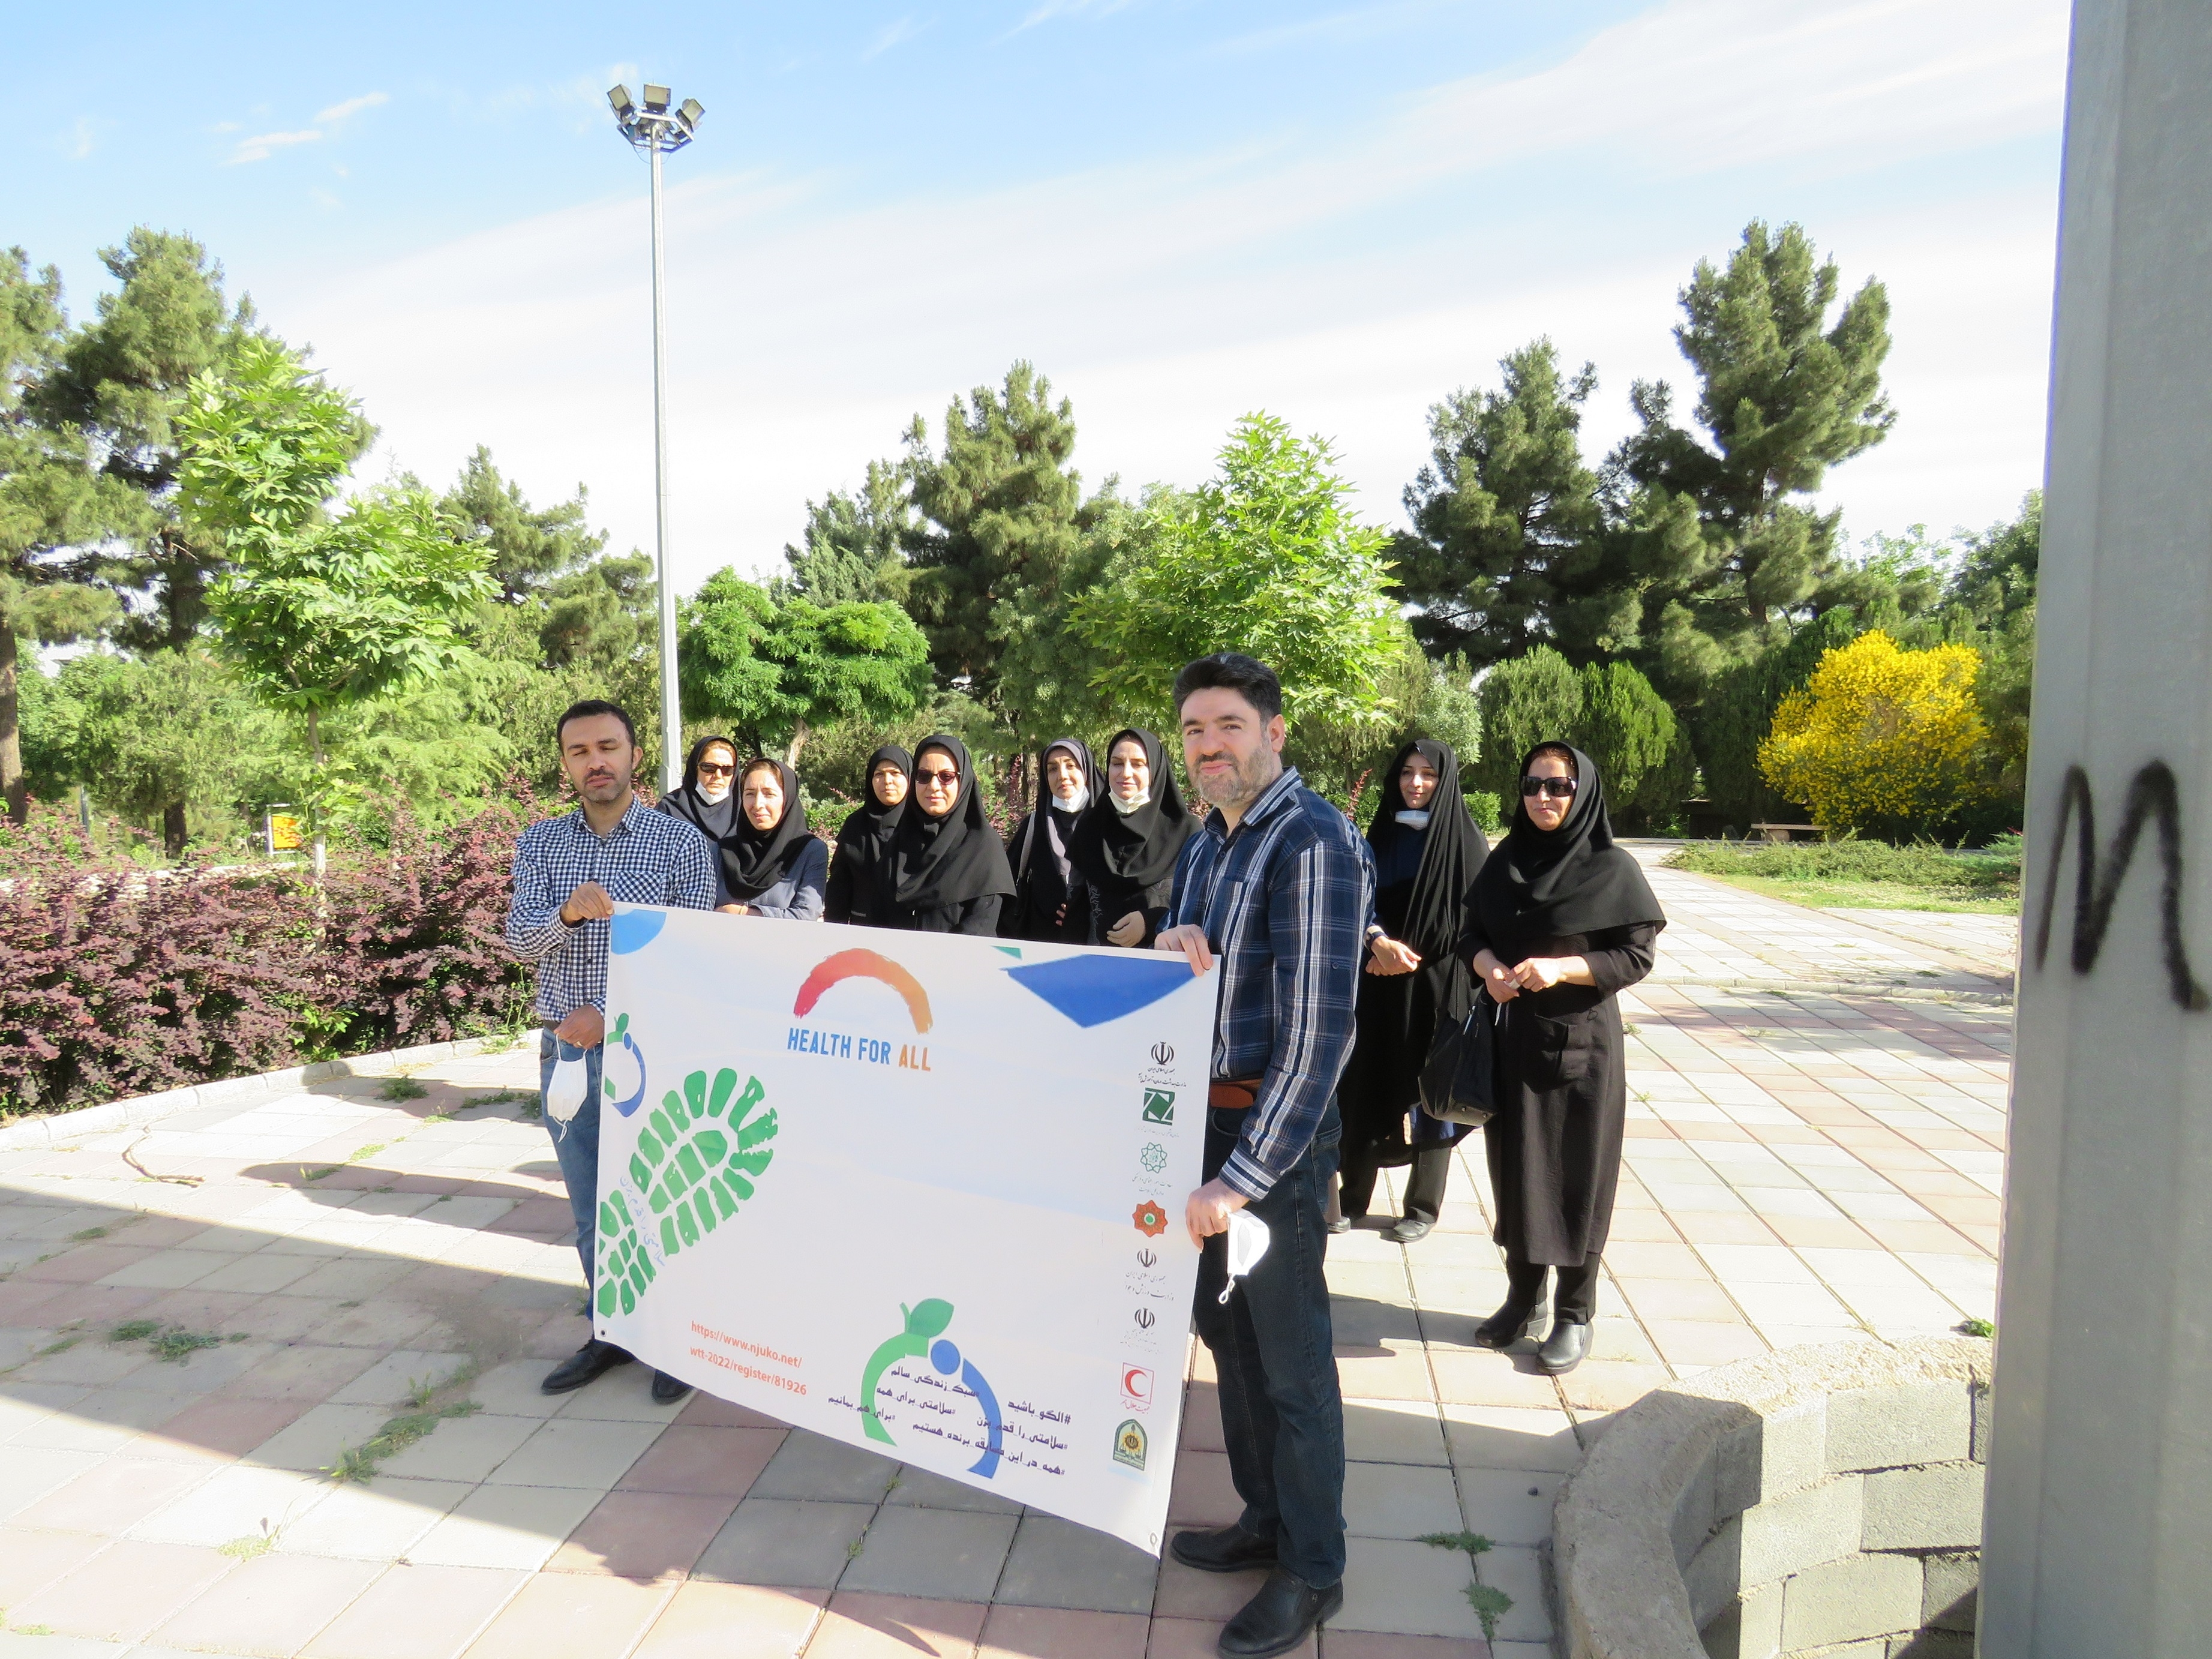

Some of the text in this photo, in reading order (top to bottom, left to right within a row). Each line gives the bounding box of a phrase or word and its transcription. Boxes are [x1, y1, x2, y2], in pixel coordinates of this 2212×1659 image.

[787, 1027, 931, 1072] HEALTH FOR ALL
[691, 1320, 803, 1368] https://www.njuko.net/
[690, 1346, 807, 1396] wtt-2022/register/81926
